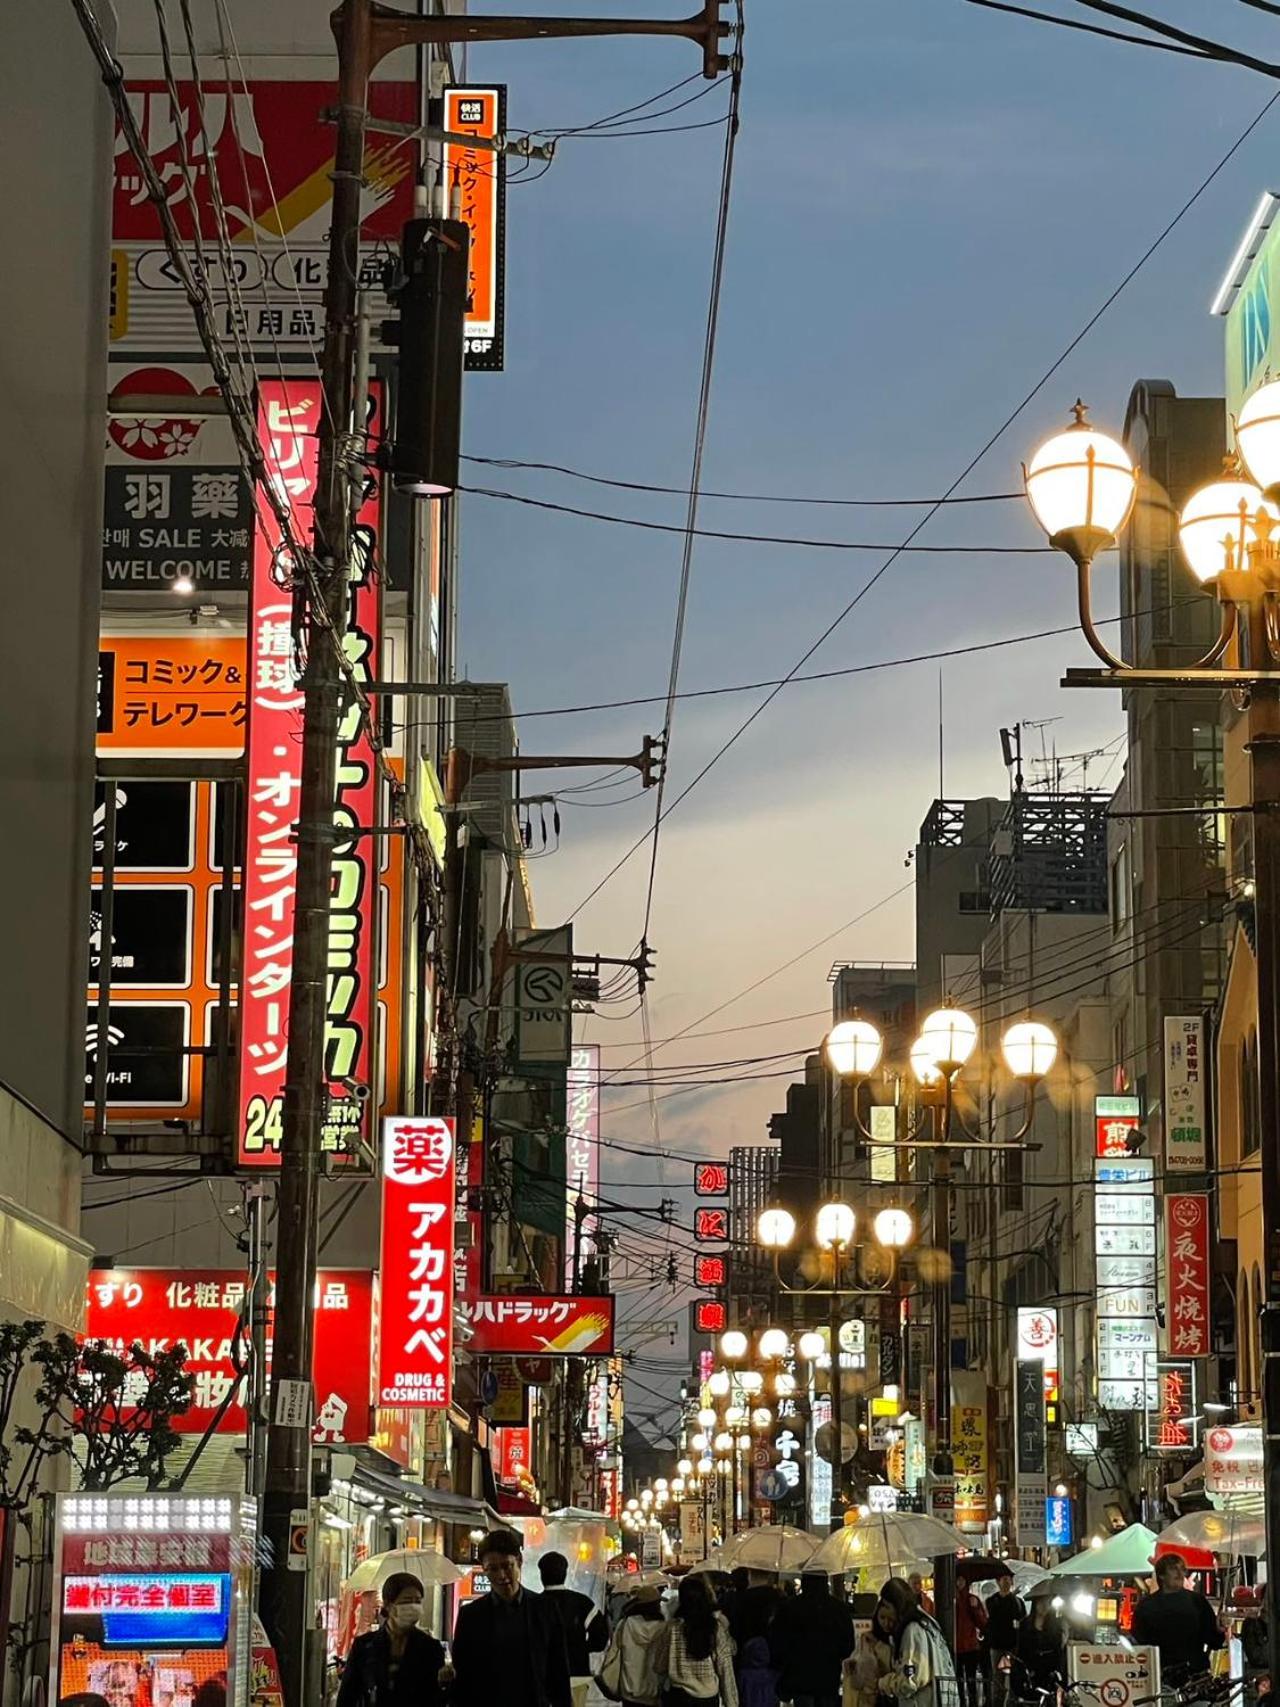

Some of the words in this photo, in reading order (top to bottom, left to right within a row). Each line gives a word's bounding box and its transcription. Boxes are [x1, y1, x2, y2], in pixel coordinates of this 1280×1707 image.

[114, 162, 206, 206] ッグ
[295, 257, 385, 283] 化品
[226, 310, 315, 335] 日用品
[139, 529, 200, 548] SALE
[106, 560, 230, 579] WELCOME
[123, 700, 246, 727] テレワーク
[94, 840, 128, 851] ラケ
[245, 1098, 283, 1149] 24
[394, 1125, 446, 1178] 薬
[85, 1282, 143, 1308] すり
[166, 1282, 245, 1308] 化粧品
[405, 1202, 447, 1364] アカカベ
[1105, 1299, 1139, 1313] FUN
[394, 1373, 428, 1386] DRUG
[435, 1373, 445, 1386] &
[382, 1388, 445, 1401] COSMETIC
